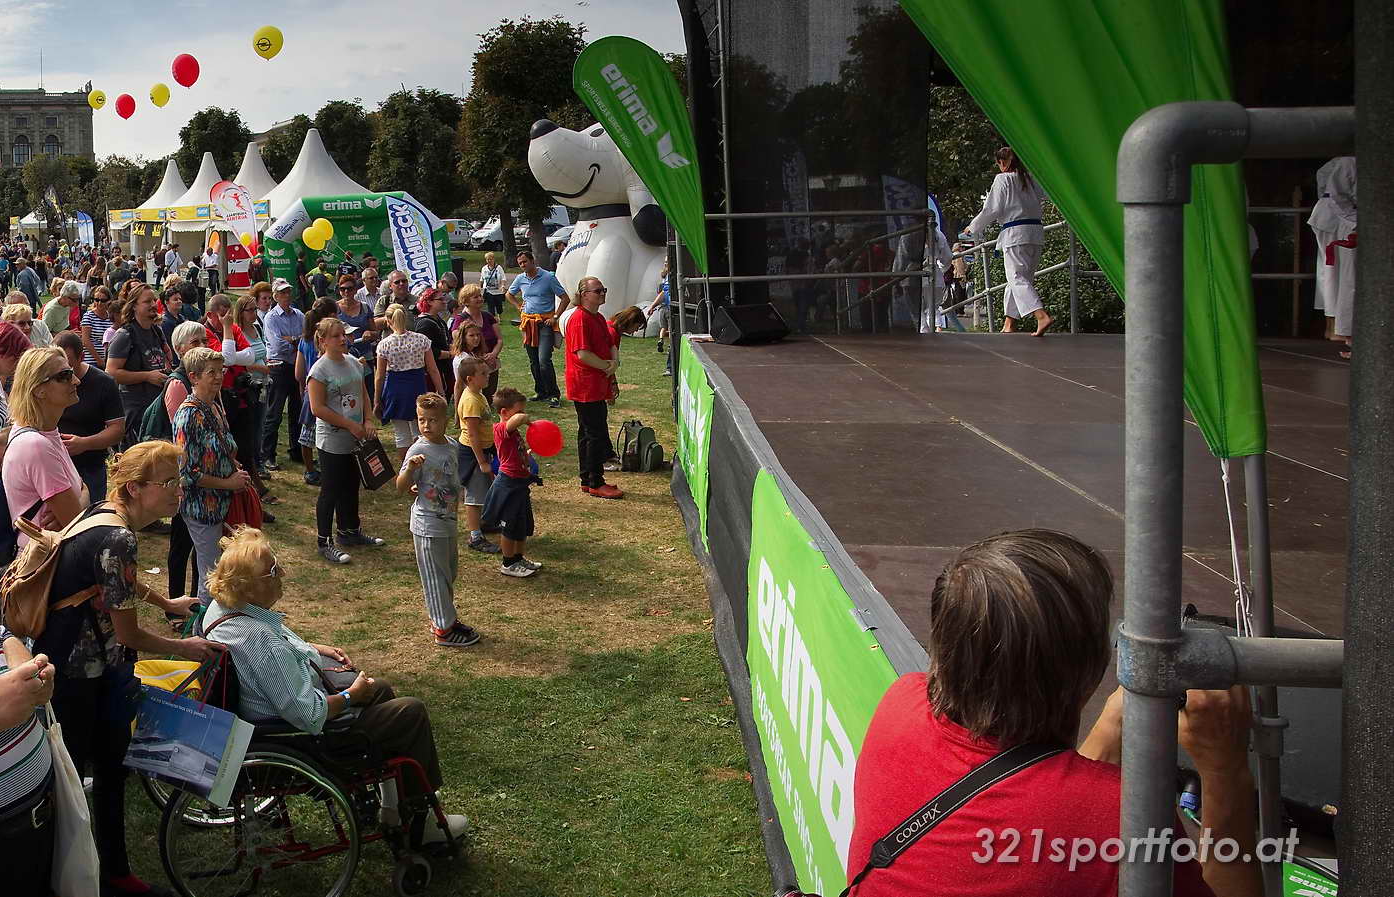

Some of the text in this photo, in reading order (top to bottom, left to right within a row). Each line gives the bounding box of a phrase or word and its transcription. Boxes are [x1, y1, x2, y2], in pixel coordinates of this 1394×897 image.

[600, 63, 658, 137] erima
[322, 199, 362, 211] erima
[757, 556, 857, 877] erima
[896, 803, 941, 843] COOLPIX
